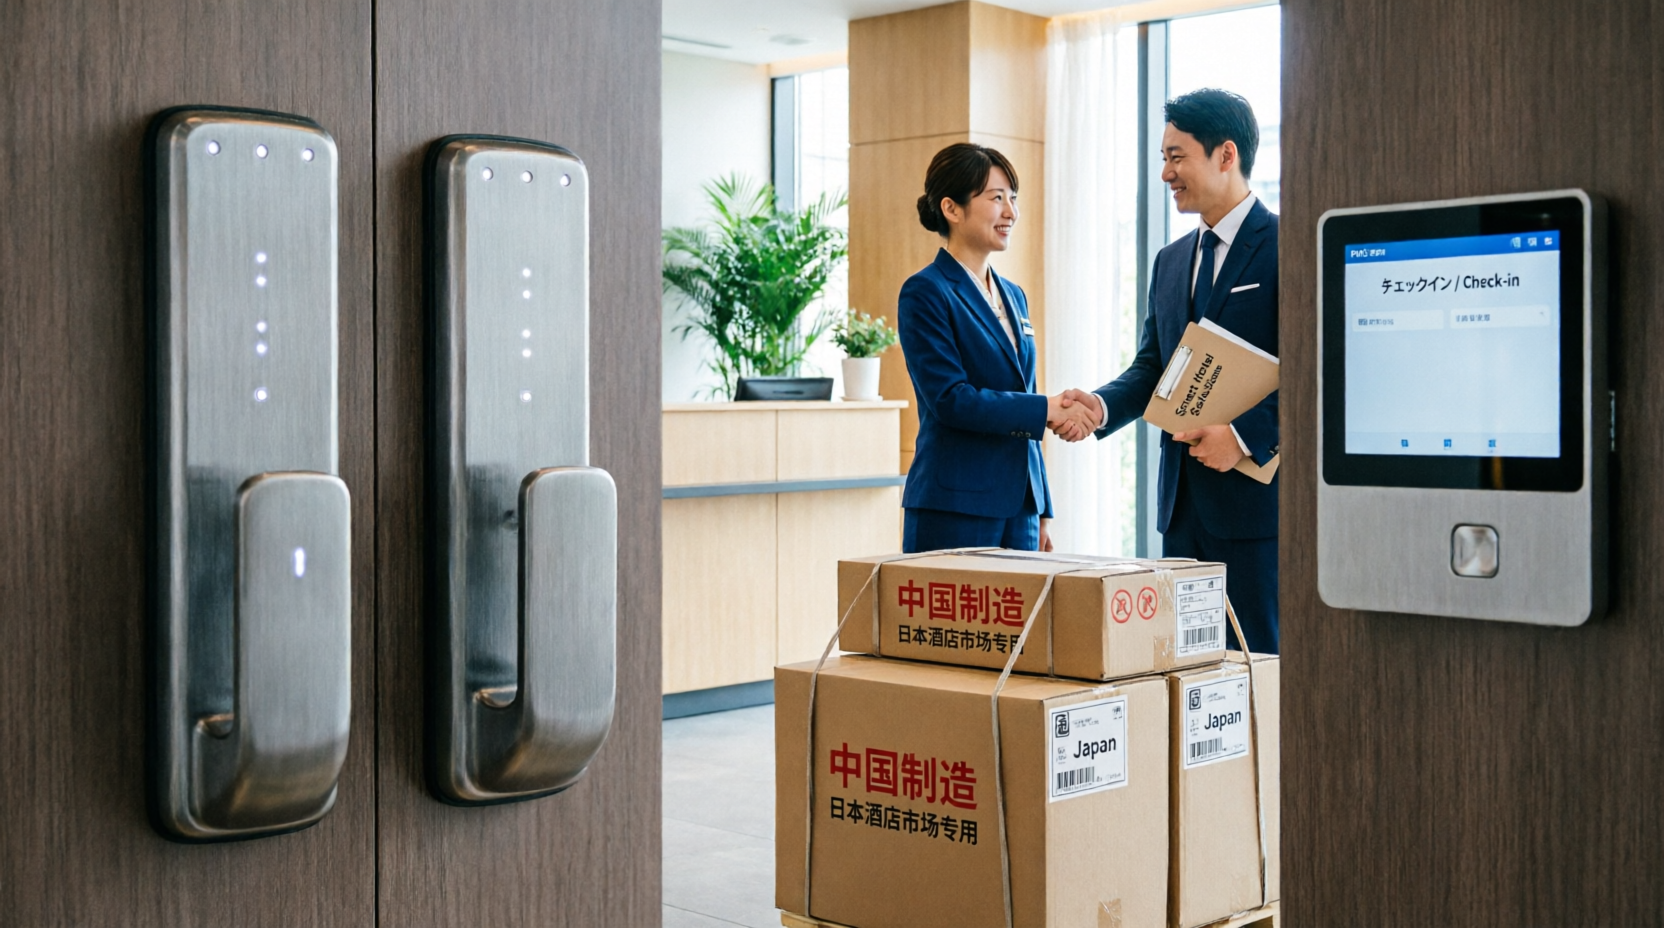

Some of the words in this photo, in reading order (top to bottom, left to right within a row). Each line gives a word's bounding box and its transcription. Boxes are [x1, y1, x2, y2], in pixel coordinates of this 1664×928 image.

[1381, 276, 1452, 294] チェックイン
[1454, 275, 1460, 292] /
[1463, 272, 1520, 289] Check-in
[898, 579, 1025, 627] 中国制造
[1204, 711, 1242, 731] Japan
[1073, 737, 1117, 760] Japan
[830, 742, 978, 810] 中国制造
[830, 796, 978, 846] 日本酒店市场专用
